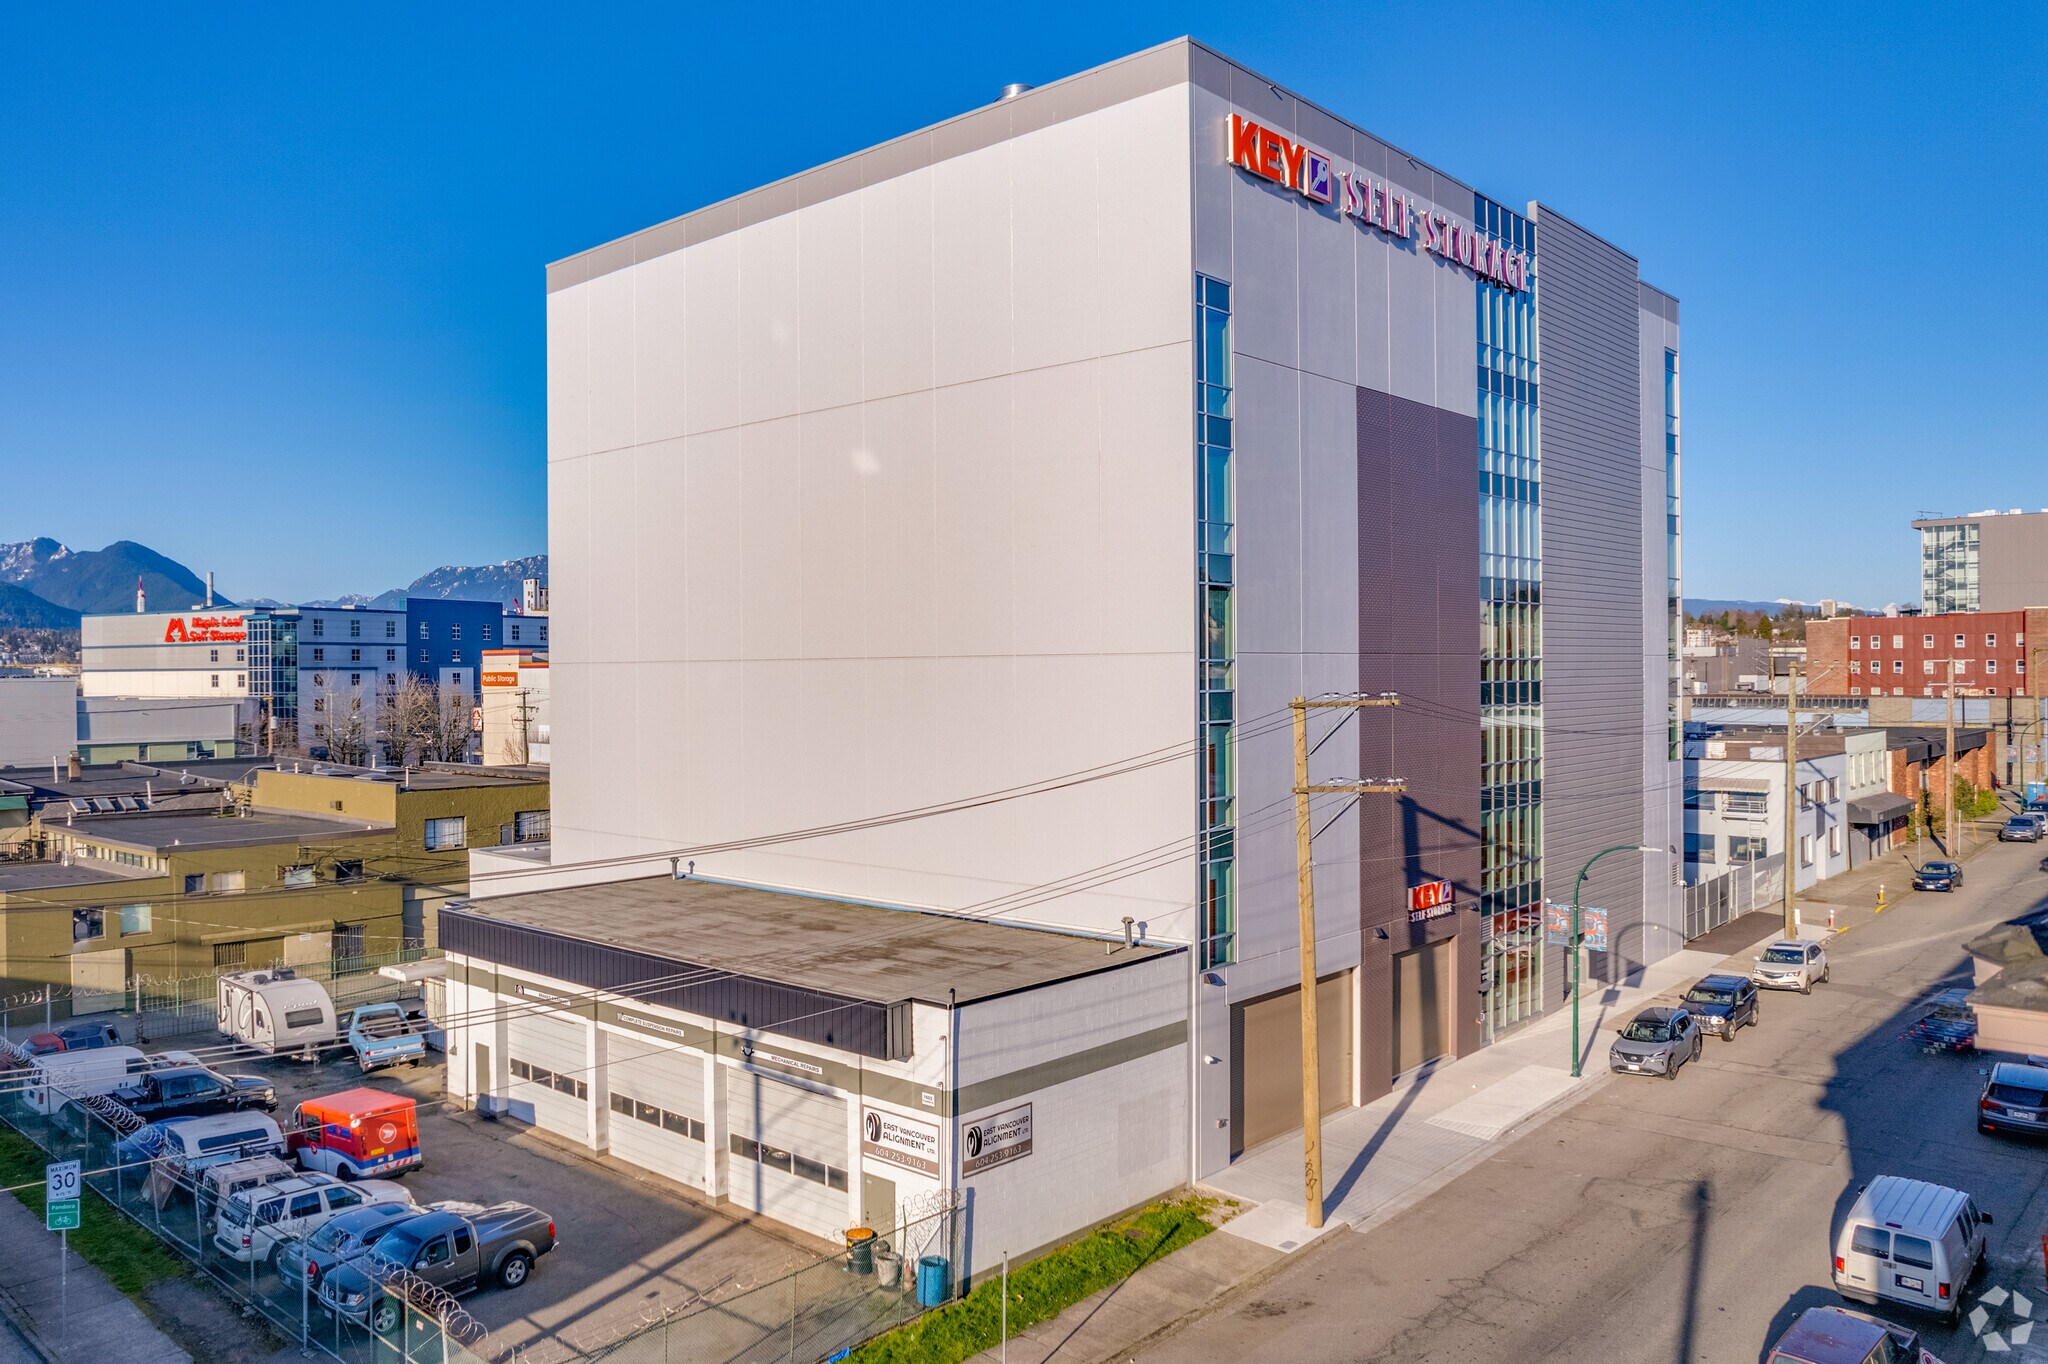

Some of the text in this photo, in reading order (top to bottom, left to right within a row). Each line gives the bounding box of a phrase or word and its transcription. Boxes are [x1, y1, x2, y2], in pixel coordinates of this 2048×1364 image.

[1228, 113, 1305, 189] KEY
[1345, 171, 1530, 293] SELF STORAGE
[209, 629, 247, 643] Storage
[497, 674, 515, 684] Storage
[1408, 881, 1443, 911] KEY
[1411, 909, 1426, 922] SELF
[623, 1015, 683, 1036] COMPLETE SUSPENSION REPAIRS
[770, 1055, 820, 1073] MECHANICAL REPAIRS
[883, 1122, 936, 1143] EAST VANCOUVER
[983, 1115, 1029, 1137] EAST VANCOUVER
[883, 1131, 925, 1151] ALIGNMENT
[983, 1127, 1021, 1147] ALIGNMENT
[50, 1163, 77, 1173] MAXIMUM
[52, 1172, 75, 1190] 30
